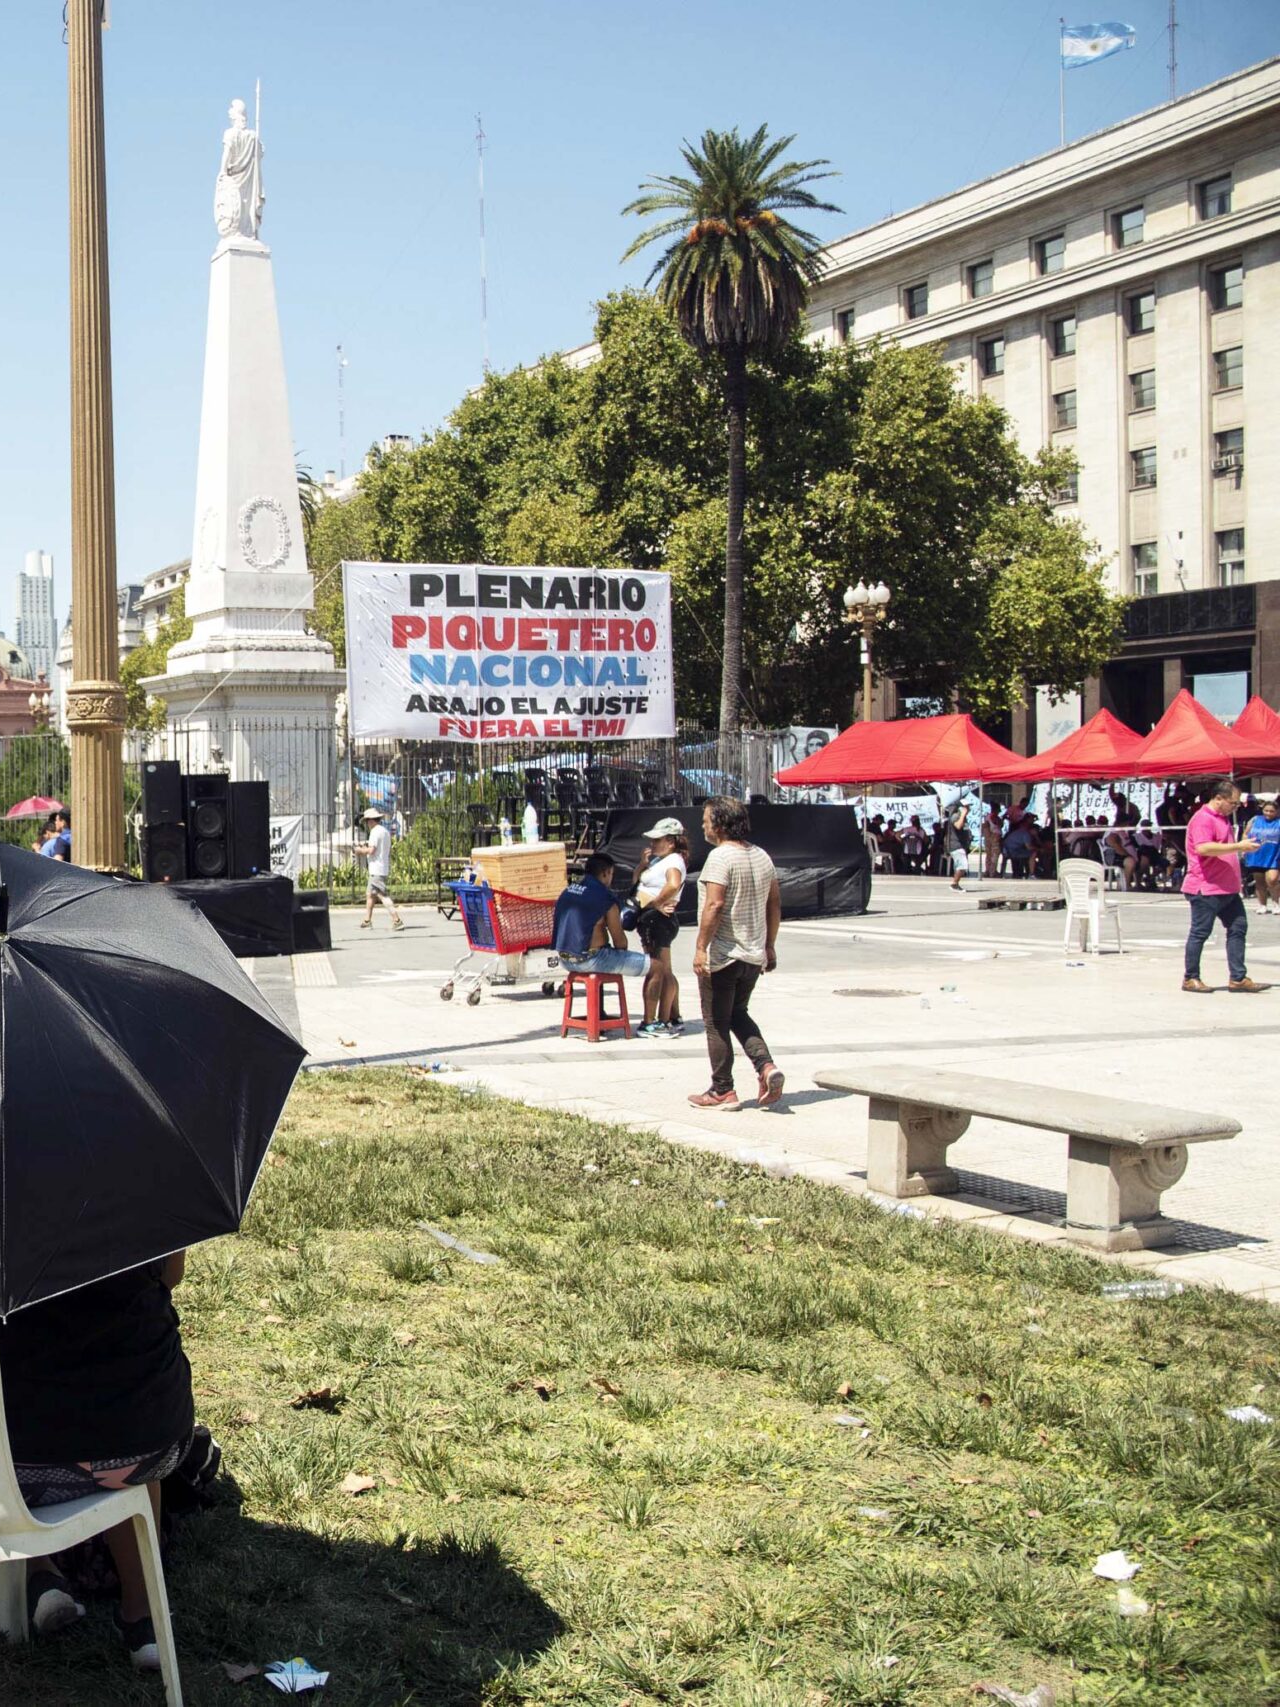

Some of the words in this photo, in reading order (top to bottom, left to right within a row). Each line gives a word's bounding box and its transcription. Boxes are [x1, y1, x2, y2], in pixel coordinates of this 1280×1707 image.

[409, 573, 647, 612] PLENARIO
[391, 615, 657, 652] PIQUETERO
[409, 654, 648, 687] NACIONAL
[405, 694, 506, 716] ABAJO
[512, 697, 547, 715] EL
[553, 696, 649, 715] AJUSTE
[438, 718, 539, 739] FUERA
[543, 719, 579, 737] EL
[581, 719, 626, 737] FMI
[886, 802, 909, 812] MTR
